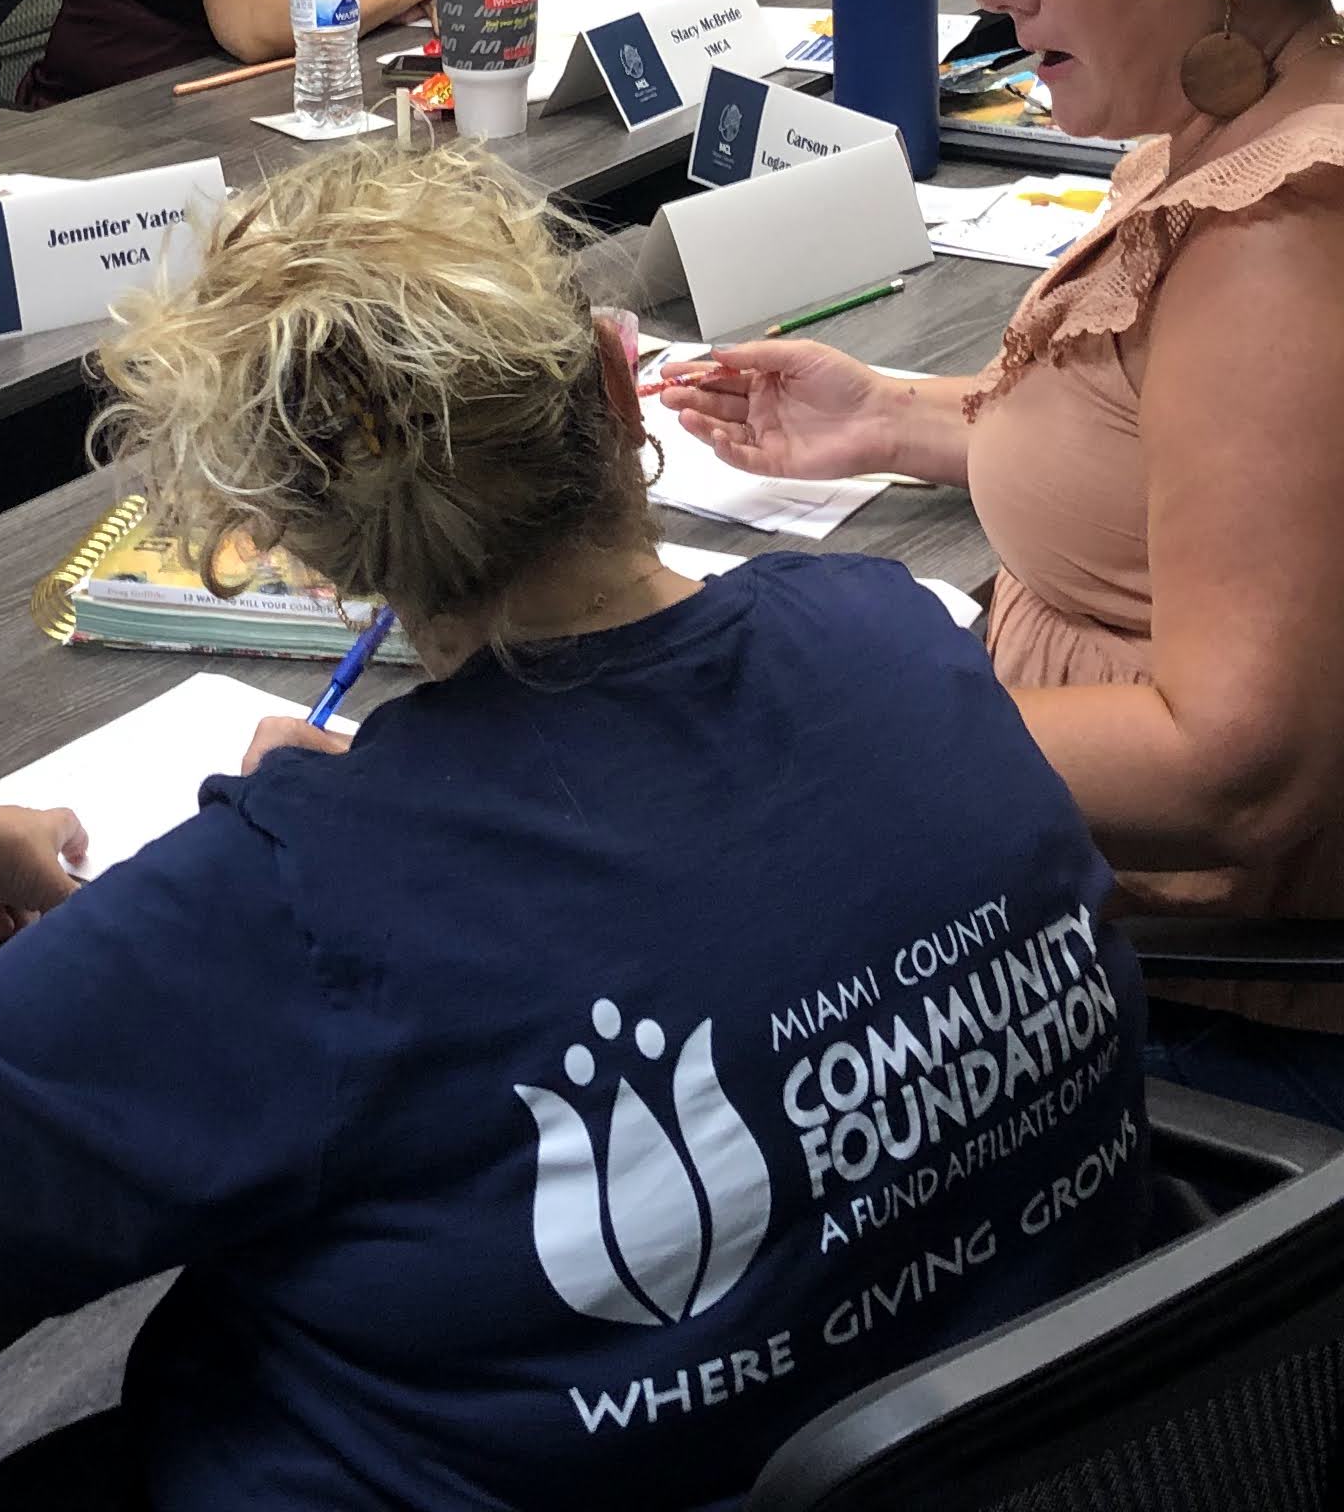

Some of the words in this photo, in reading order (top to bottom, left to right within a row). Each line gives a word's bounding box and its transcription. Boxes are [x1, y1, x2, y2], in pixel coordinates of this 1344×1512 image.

[669, 24, 700, 45] Stacy
[699, 6, 743, 33] McBride
[703, 38, 732, 58] YMCA
[786, 128, 829, 157] Carson
[47, 217, 132, 248] Jennifer
[100, 246, 151, 271] YMCA
[239, 599, 260, 609] KILL
[262, 601, 288, 611] YOUR
[770, 966, 881, 1052] MIAMI
[894, 893, 1012, 988] COUNTY
[782, 901, 1100, 1130] COMMUNITY
[801, 964, 1118, 1199] FOUNDATION
[820, 1213, 849, 1254] A
[854, 1164, 939, 1239] FUND
[944, 1110, 1058, 1194] AFFILIATE
[1059, 1066, 1084, 1116] OF
[569, 1329, 797, 1433] WHERE
[823, 1221, 997, 1346] GIVING
